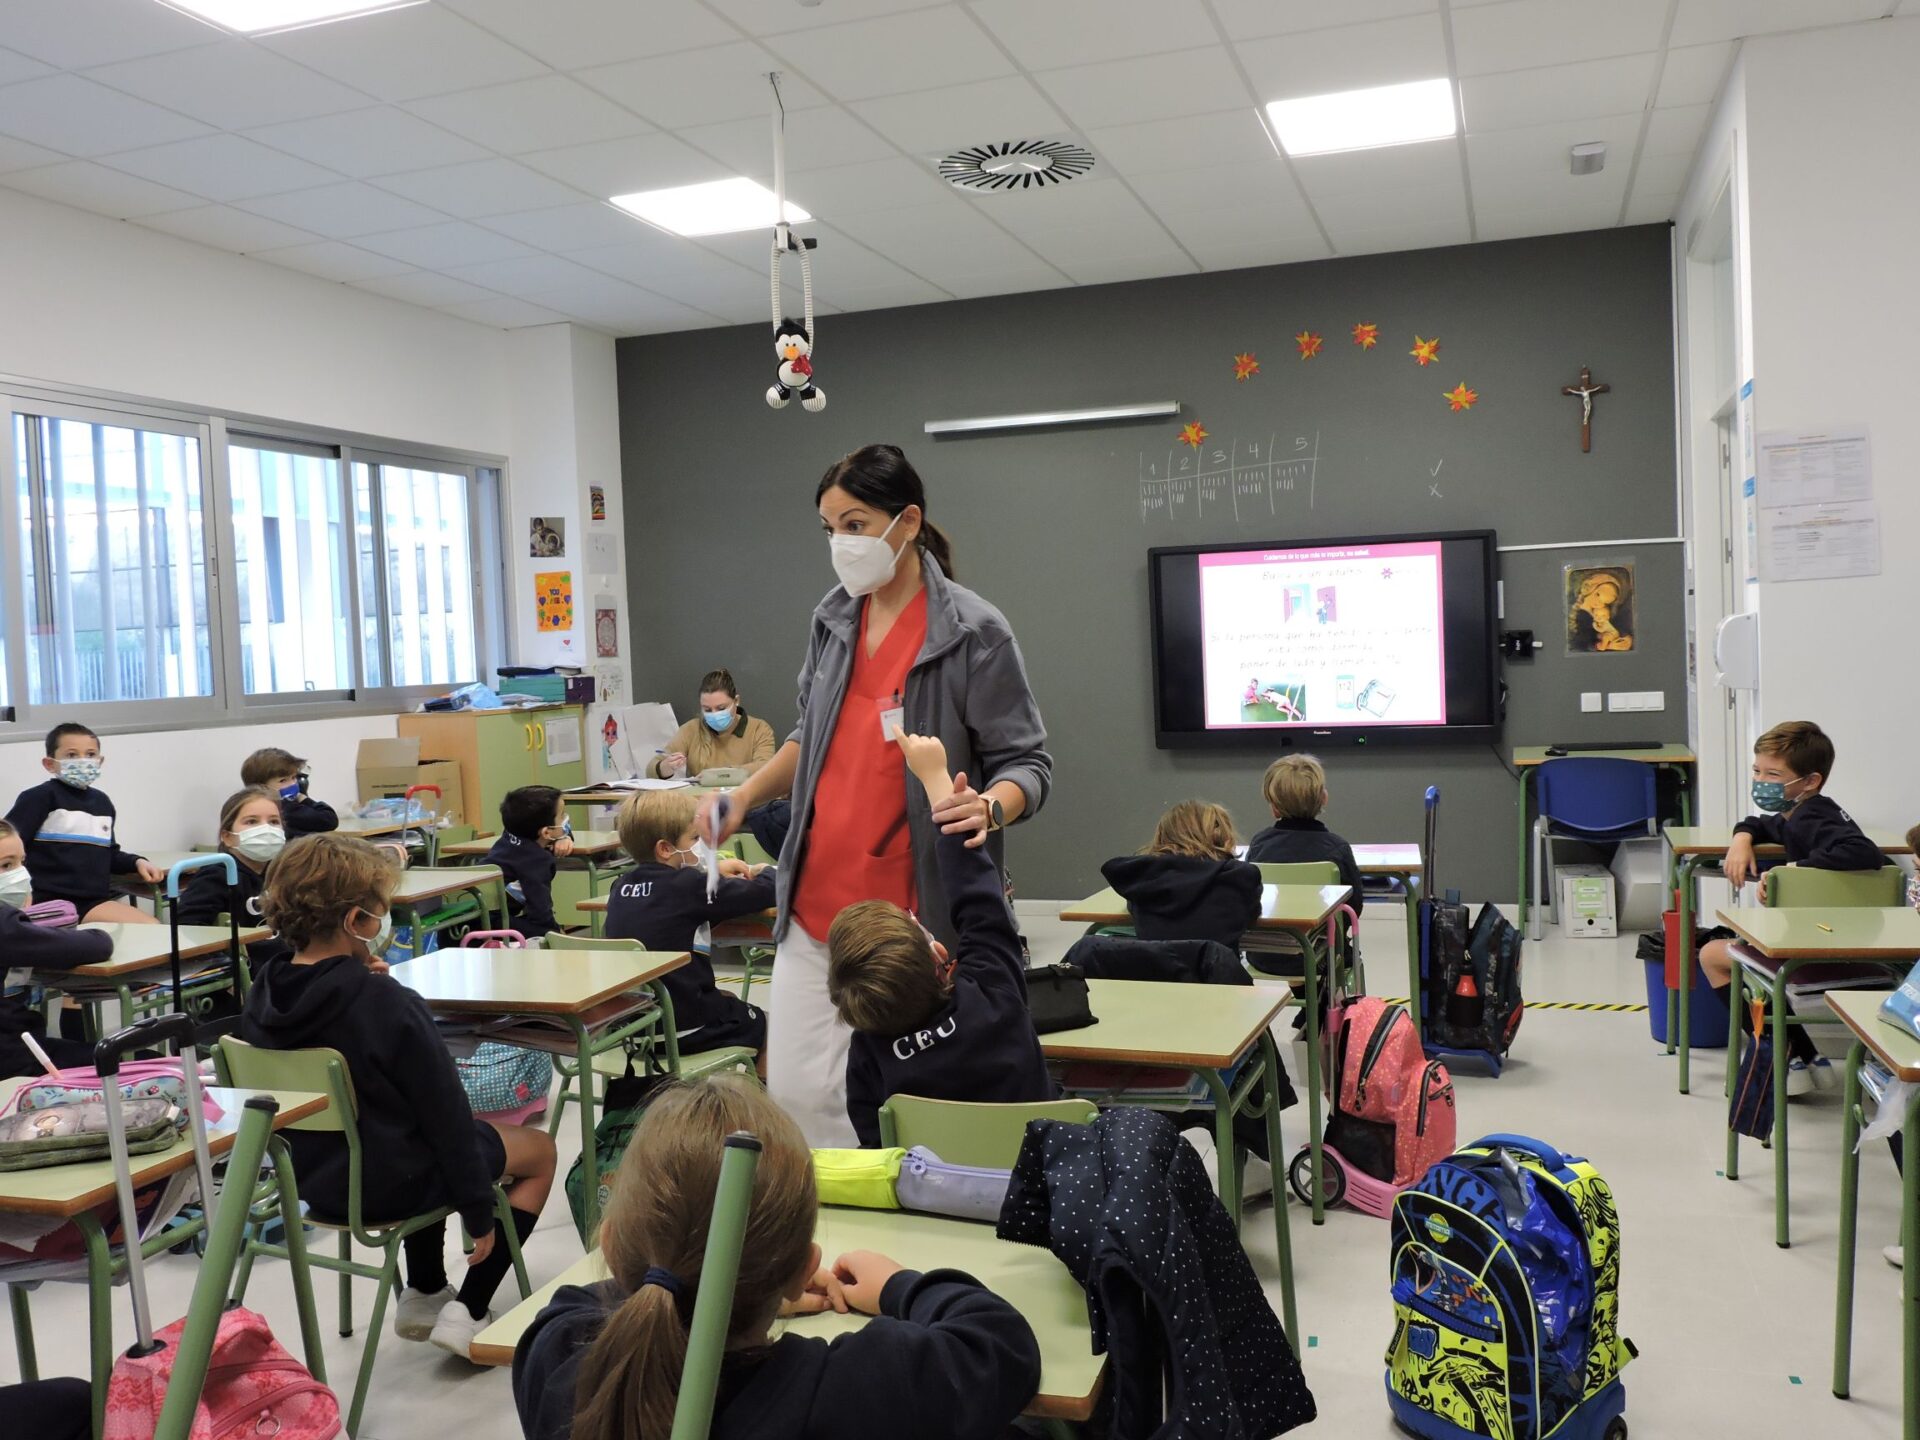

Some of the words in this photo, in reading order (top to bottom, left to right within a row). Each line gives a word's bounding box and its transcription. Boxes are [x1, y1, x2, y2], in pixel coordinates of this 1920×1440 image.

[1179, 457, 1190, 471] 2
[1212, 450, 1227, 464] 3
[1248, 442, 1260, 459] 4
[1295, 437, 1308, 451] 5
[620, 881, 653, 898] CEU
[892, 1016, 956, 1060] CEU
